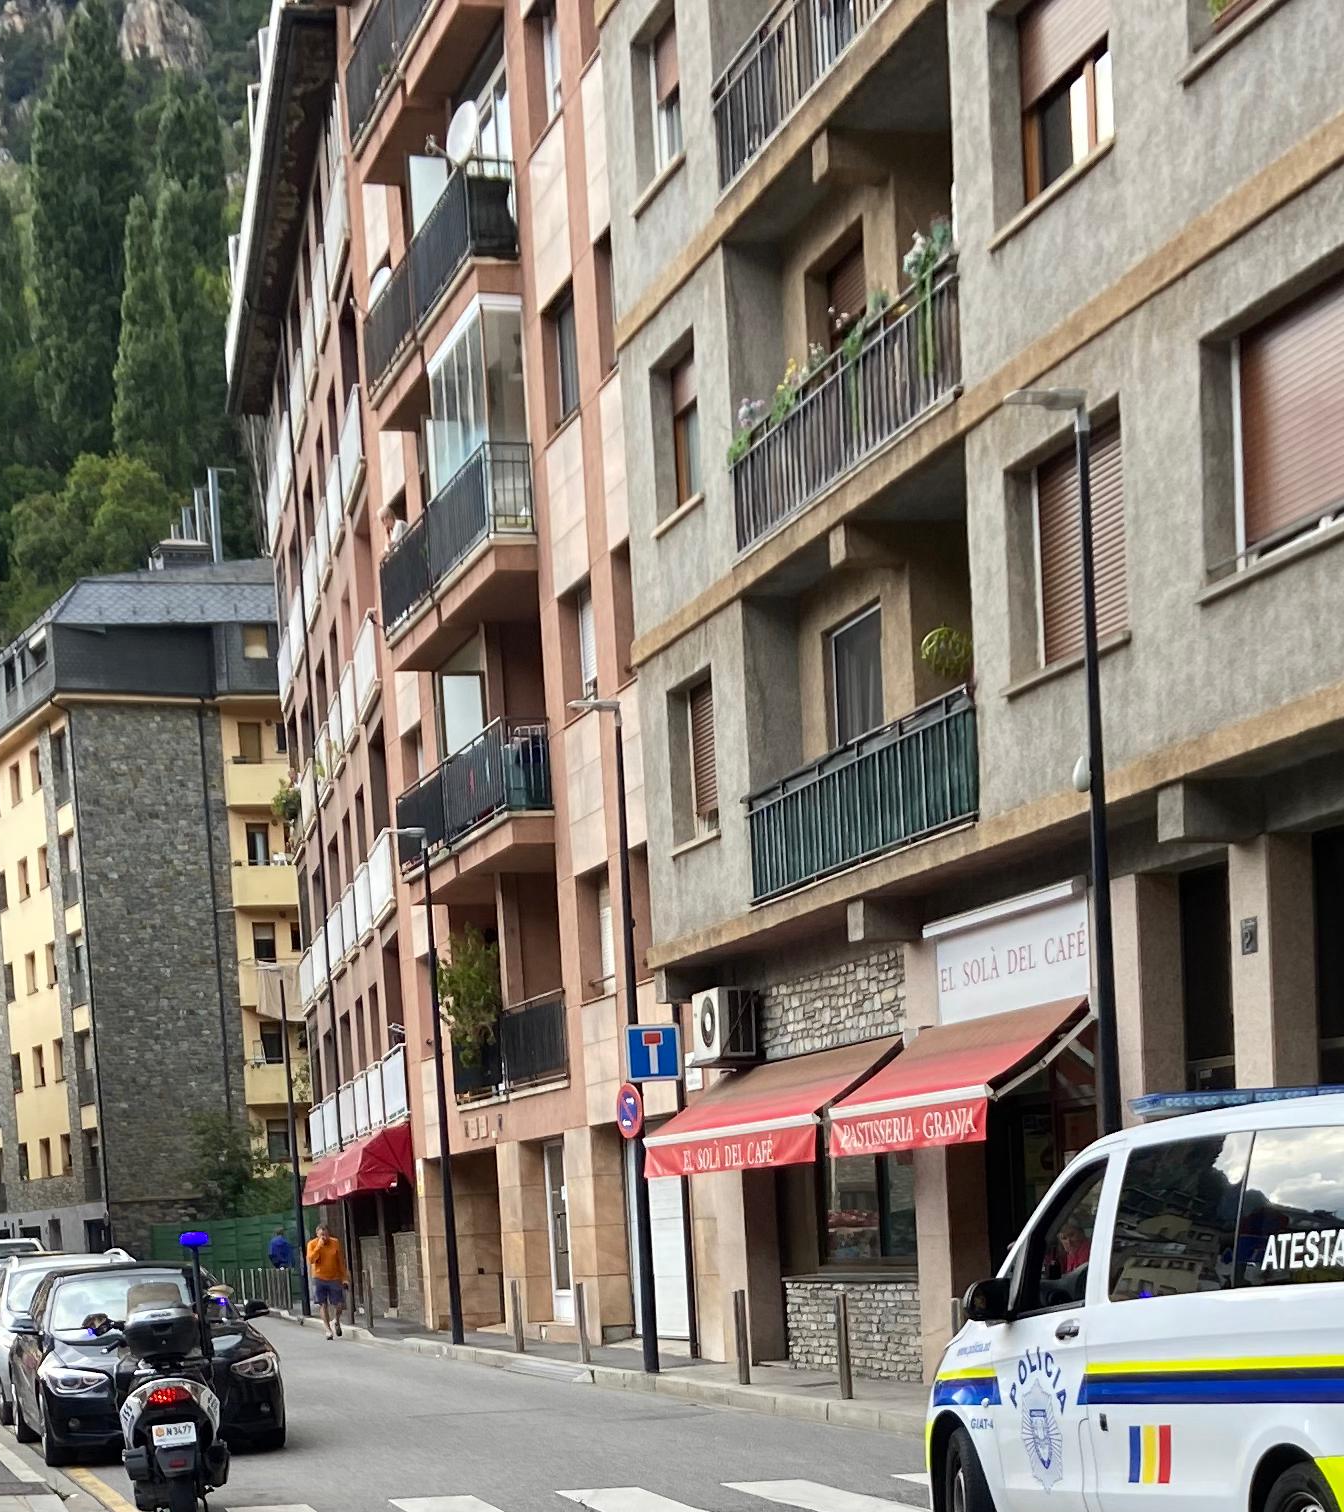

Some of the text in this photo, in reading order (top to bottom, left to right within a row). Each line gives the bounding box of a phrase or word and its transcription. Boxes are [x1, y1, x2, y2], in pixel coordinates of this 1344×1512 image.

[940, 921, 1087, 993] EL SOLÀ DEL CAFÉ
[840, 1115, 914, 1149] PASTISSERIA
[922, 1107, 977, 1140] GRANJA
[682, 1133, 774, 1172] EL SOLÀ DEL CAFÉ
